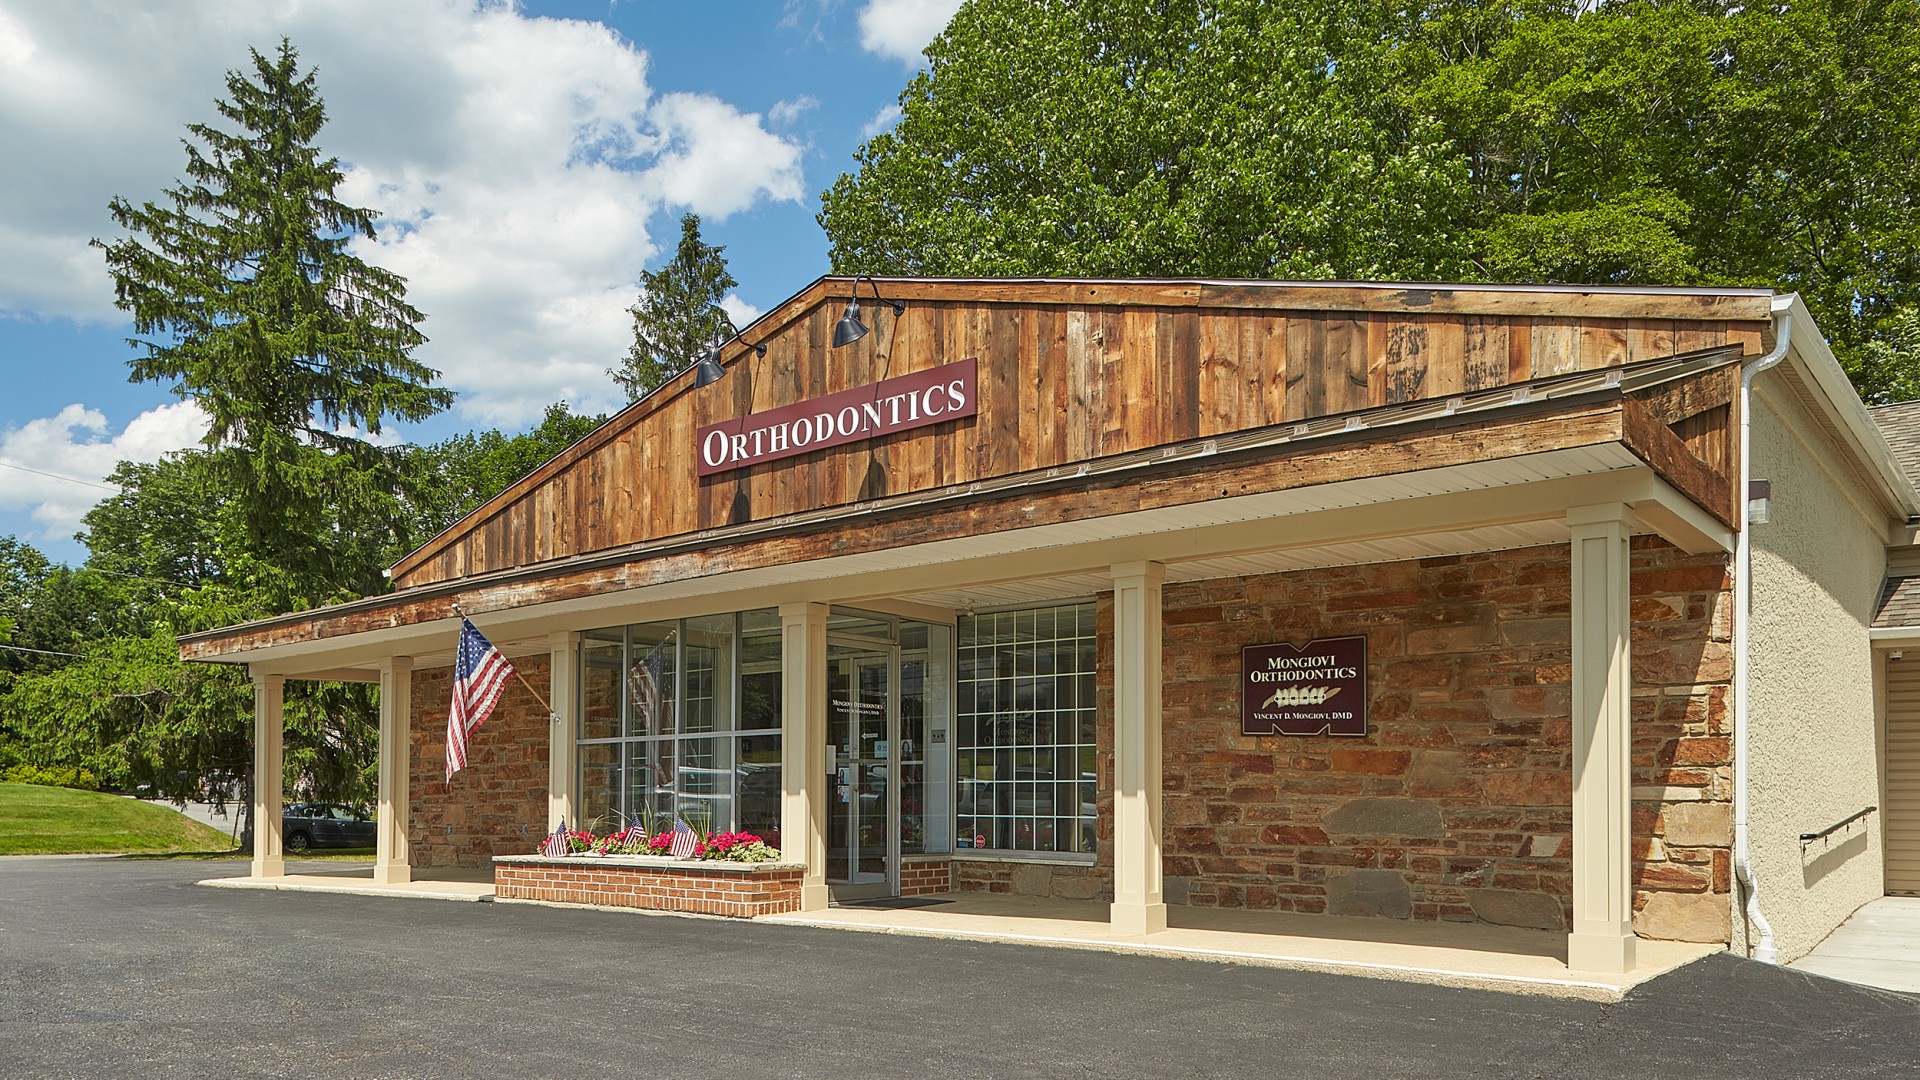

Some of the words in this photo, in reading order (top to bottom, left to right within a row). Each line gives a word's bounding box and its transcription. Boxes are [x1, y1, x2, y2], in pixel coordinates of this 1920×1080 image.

[703, 379, 966, 467] ORTHODONTICS
[1268, 655, 1335, 669] MONGIOVI
[1250, 667, 1356, 682] ORTHODONTICS
[1253, 712, 1283, 720] VINCENT
[1284, 712, 1292, 720] D.
[1292, 712, 1331, 720] MONGIOVI,
